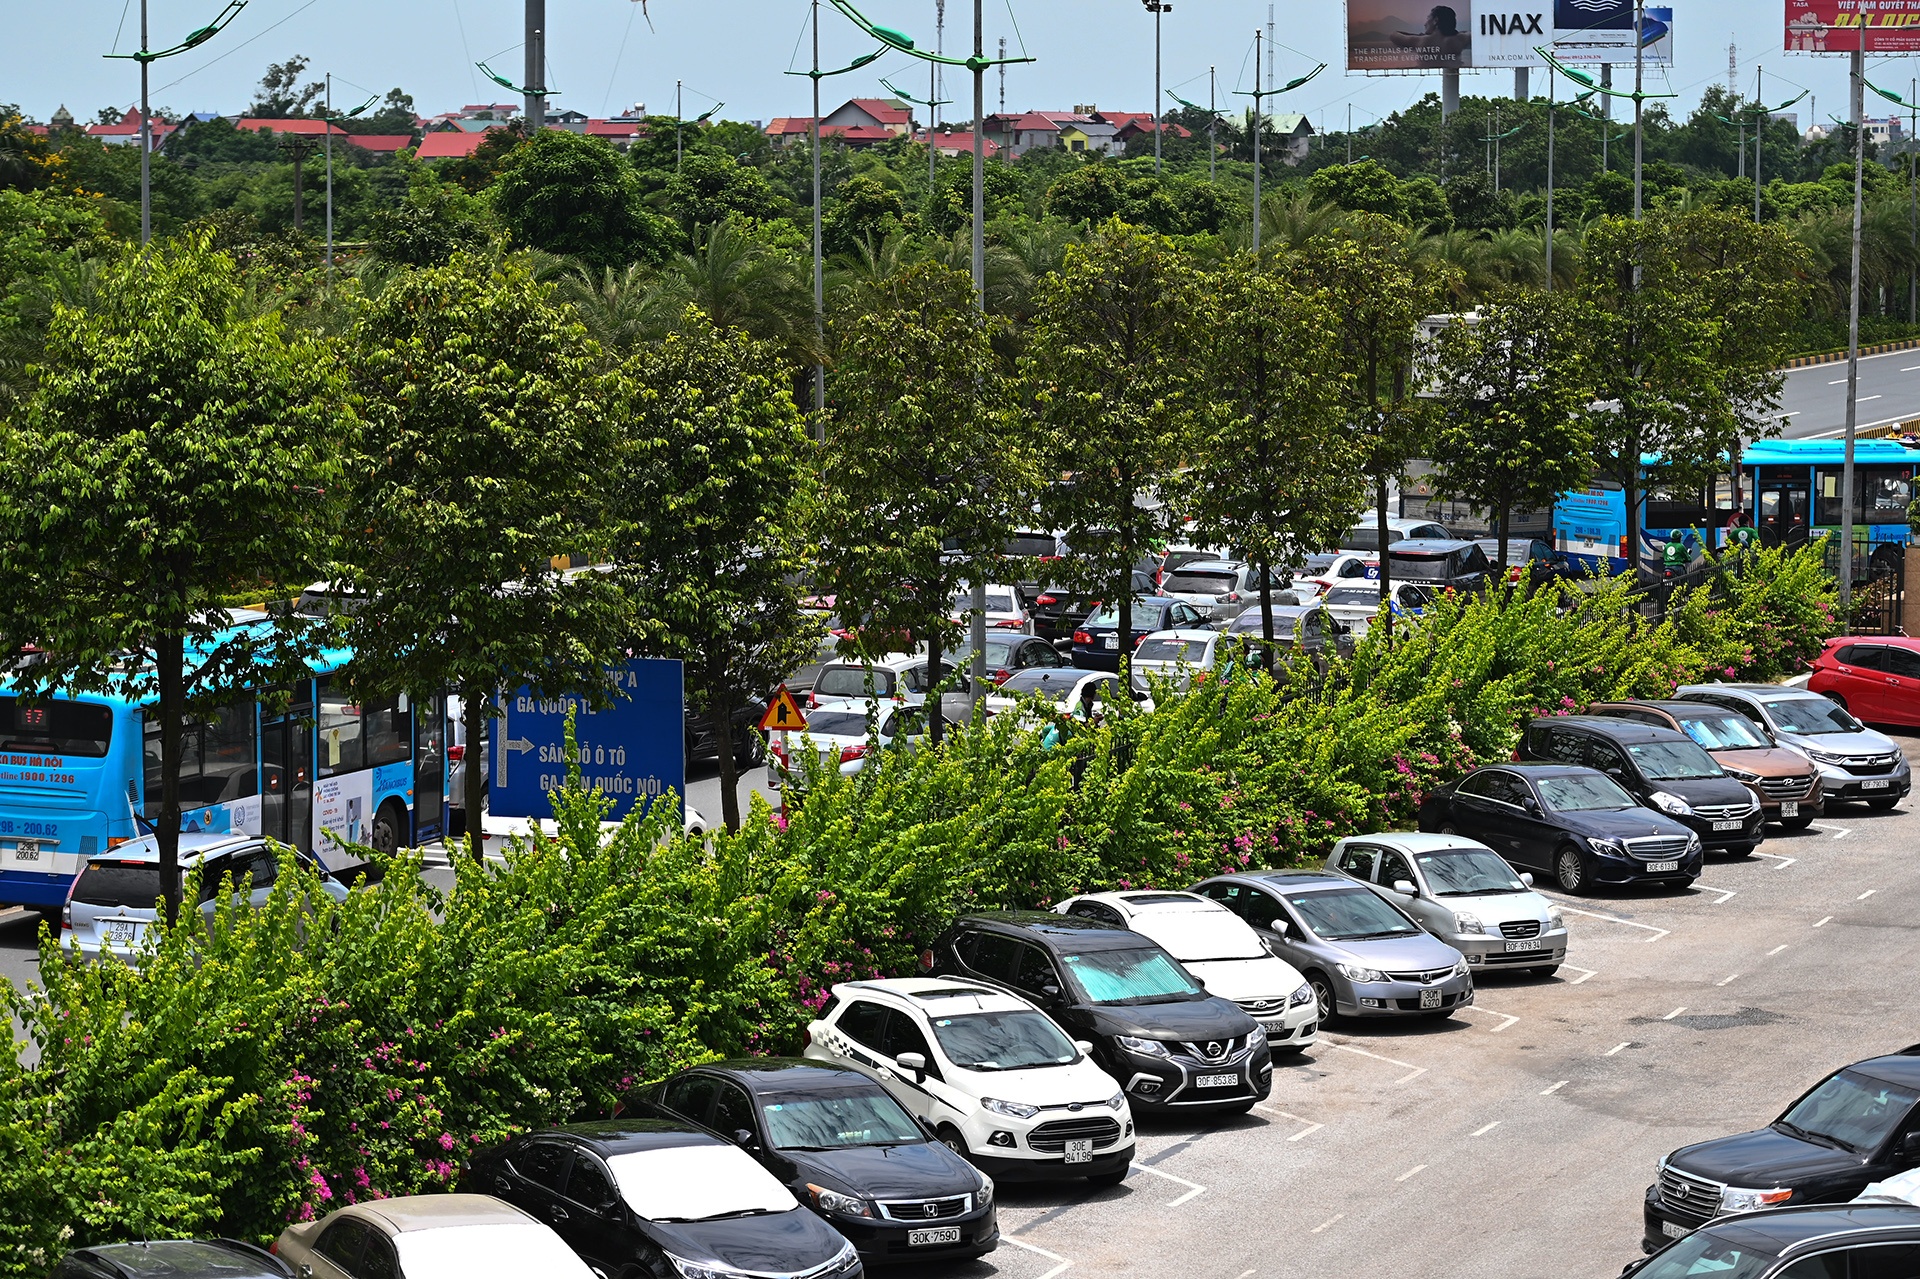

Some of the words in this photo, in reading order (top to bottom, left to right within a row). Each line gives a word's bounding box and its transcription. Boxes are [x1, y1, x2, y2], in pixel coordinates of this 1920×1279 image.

[1480, 13, 1544, 35] INAX
[1440, 53, 1456, 61] LIFE
[1367, 568, 1378, 579] G7
[628, 671, 638, 688] A
[517, 696, 536, 713] GA
[538, 742, 569, 763] SÂN
[595, 744, 605, 765] Ô
[608, 745, 626, 766] TÔ
[10, 755, 28, 765] BUS
[30, 754, 43, 767] HÀ
[44, 755, 63, 771] NỘI
[20, 771, 75, 784] 1900.1296
[539, 774, 558, 791] GA
[594, 770, 633, 794] QUỐC
[636, 774, 662, 799] NỘI
[24, 822, 58, 837] 200.62
[16, 851, 39, 860] 200.62
[115, 923, 128, 932] 29A
[1425, 990, 1438, 1000] 30M
[1422, 998, 1439, 1008] 4370
[1071, 1140, 1086, 1152] 30E
[912, 1230, 957, 1244] 30K-7590
